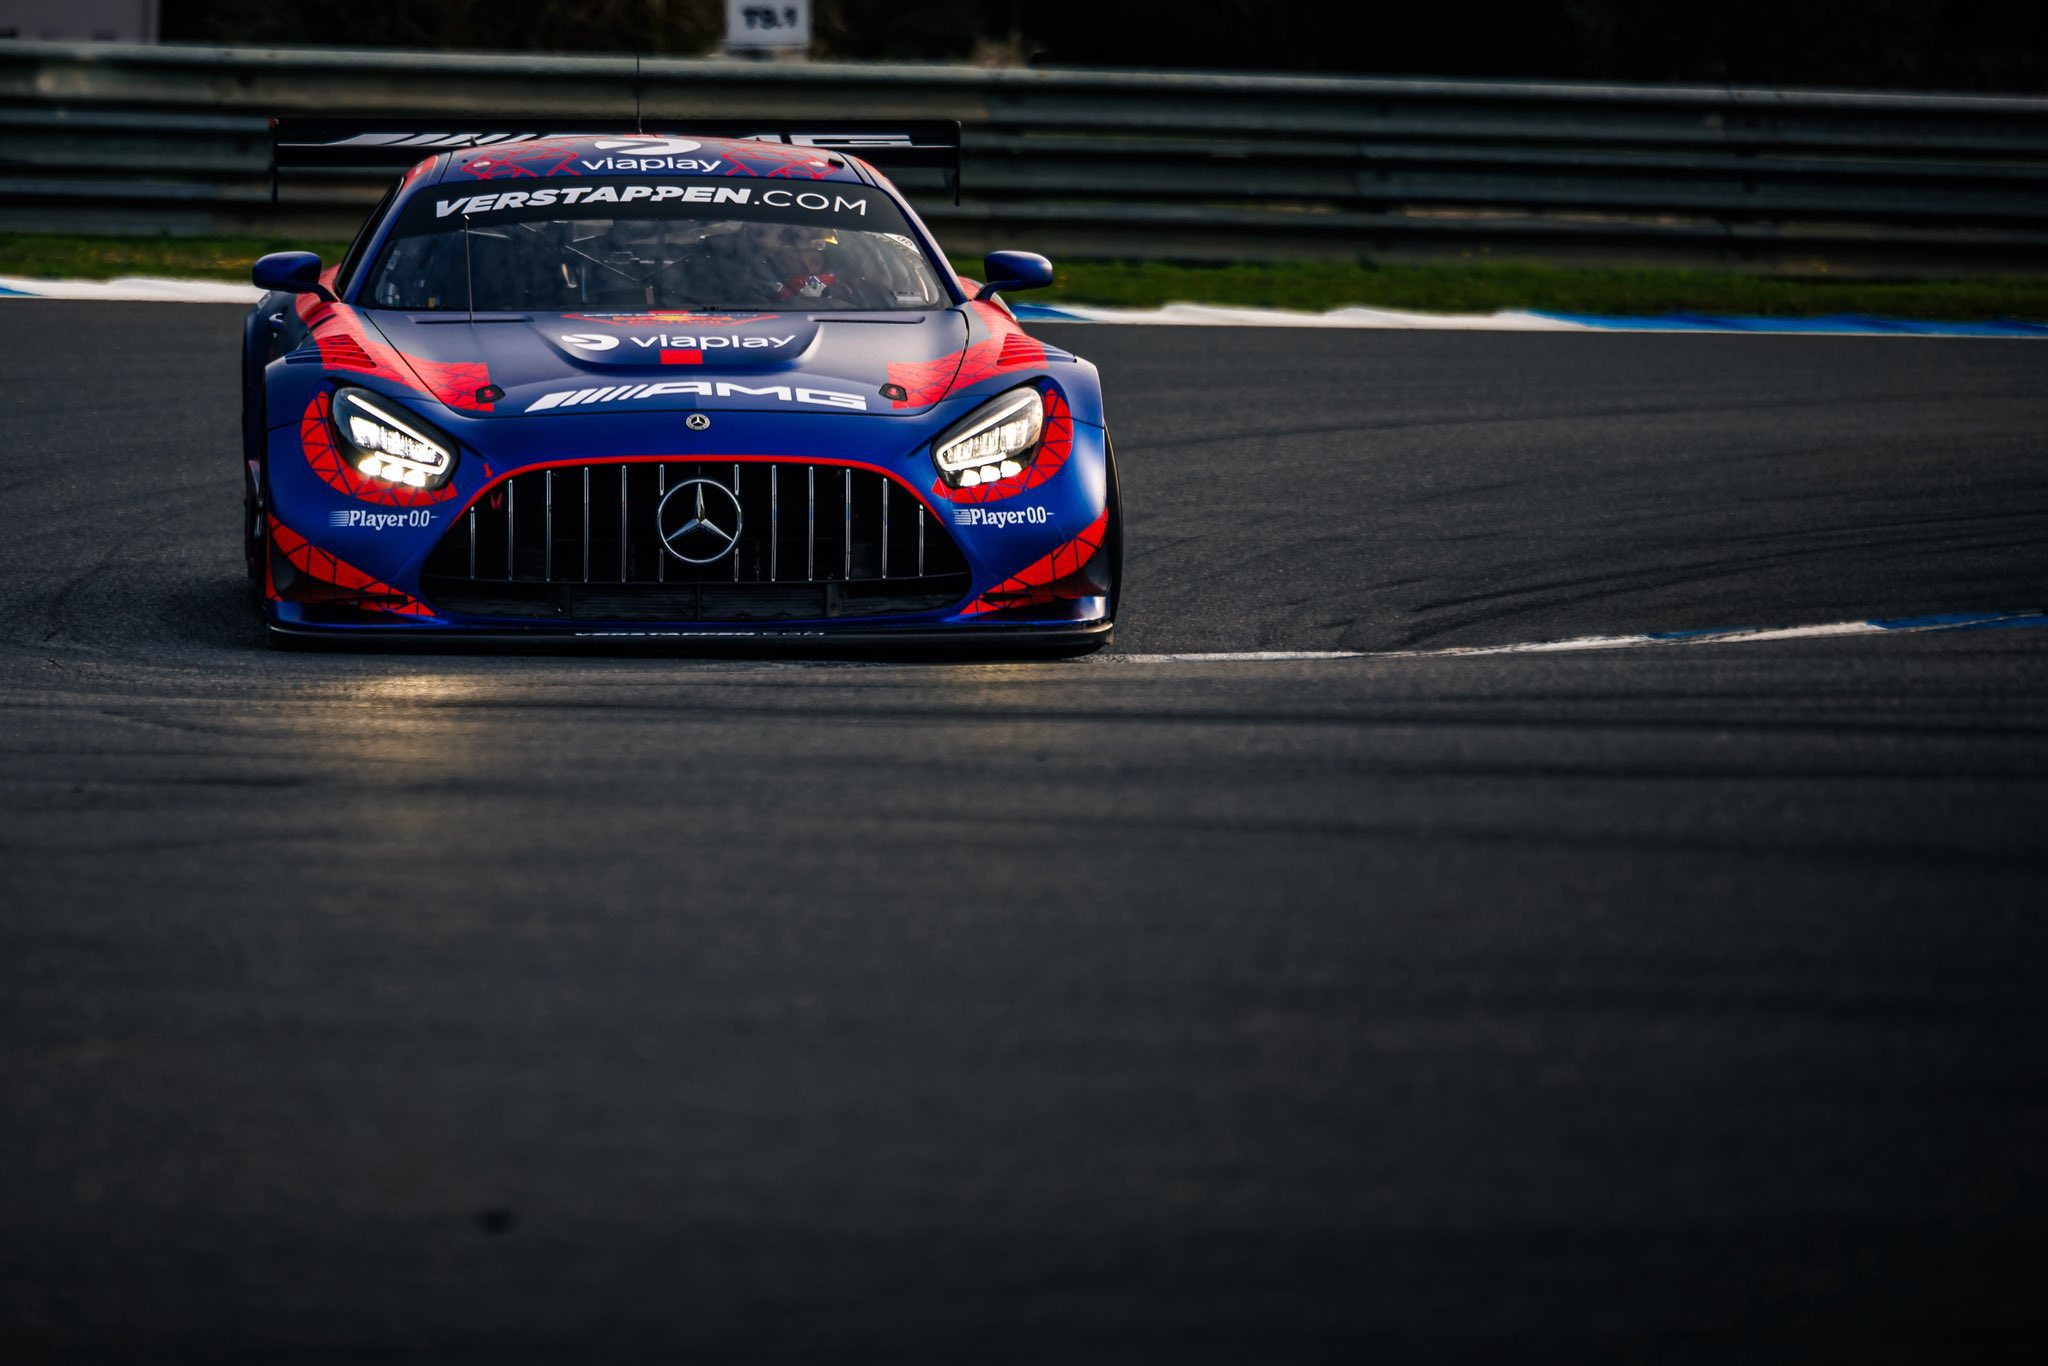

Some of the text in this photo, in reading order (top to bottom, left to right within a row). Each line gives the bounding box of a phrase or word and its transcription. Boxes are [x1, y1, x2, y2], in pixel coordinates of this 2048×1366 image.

[581, 157, 721, 172] viaplay
[436, 186, 866, 218] VERSTAPPEN.COM
[630, 334, 796, 350] viaplay
[633, 382, 867, 410] AMG
[348, 510, 408, 531] Player
[969, 508, 1026, 529] Player
